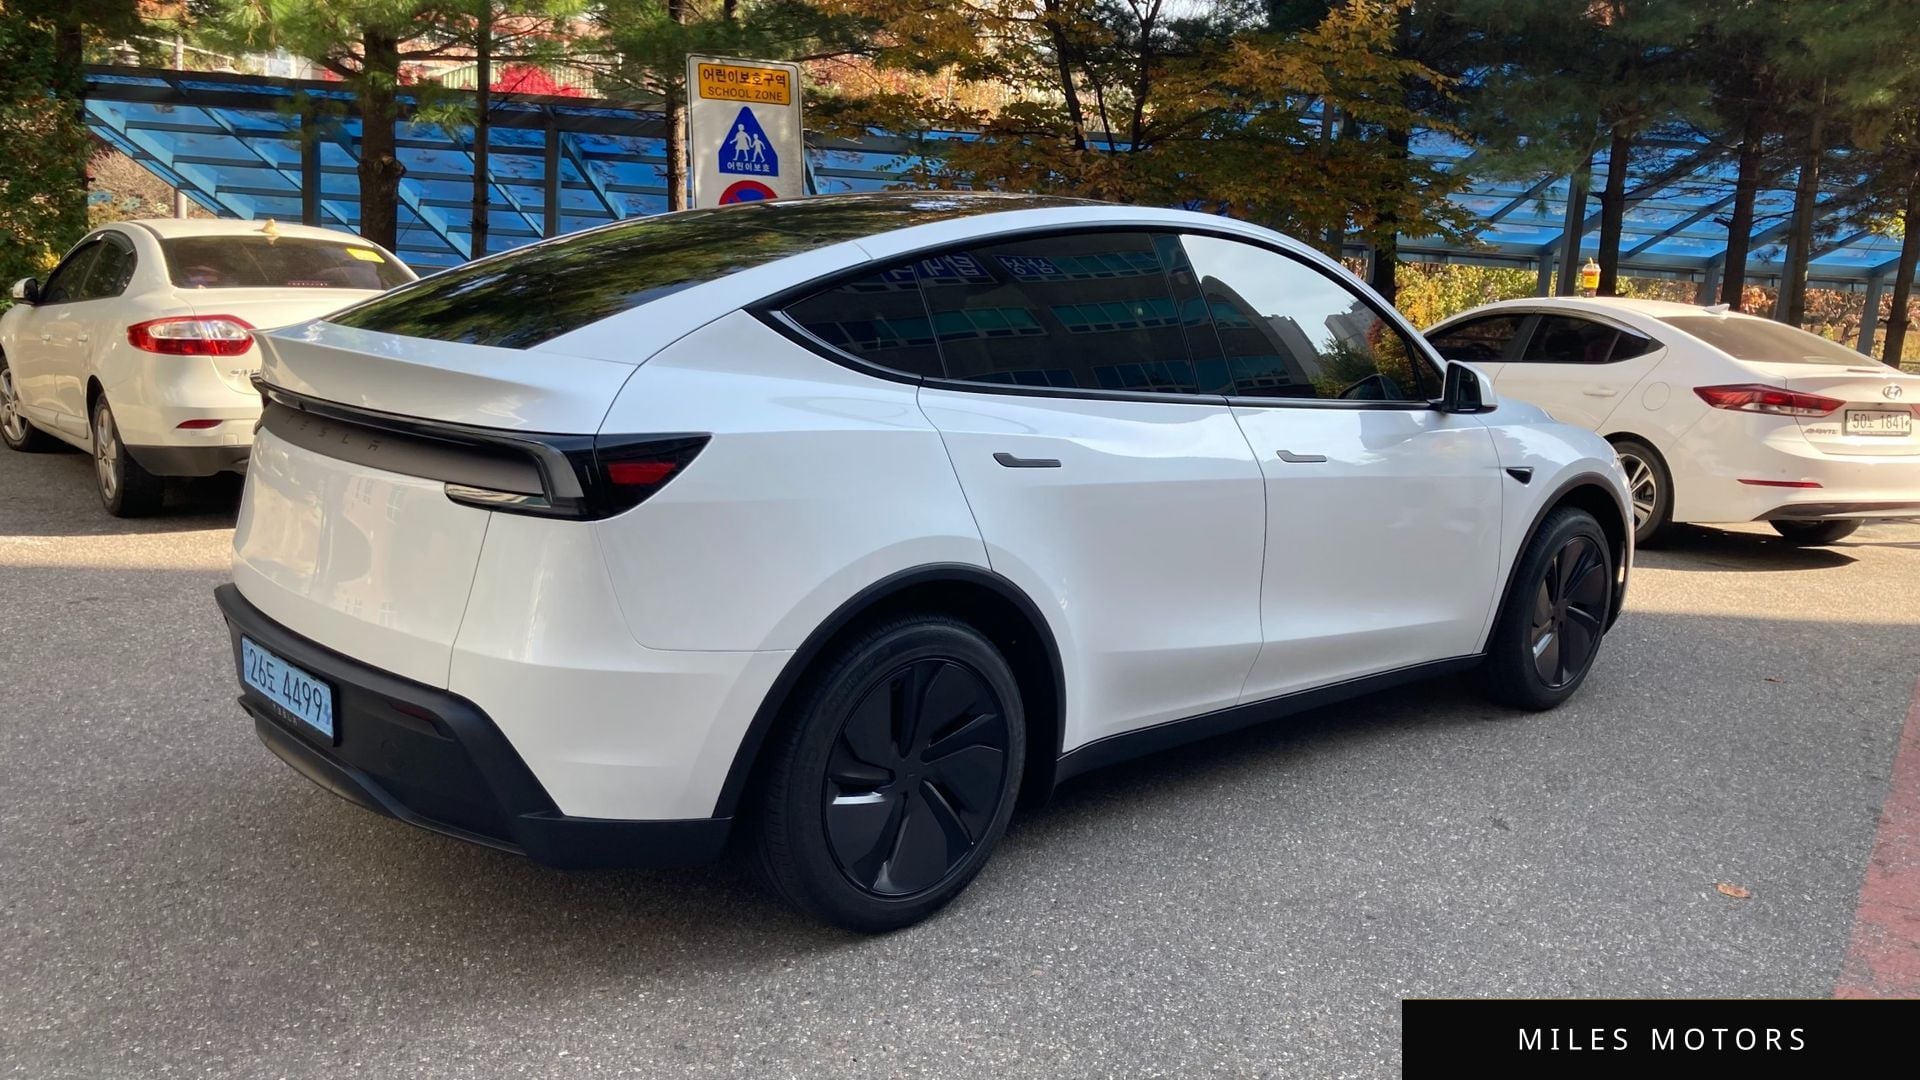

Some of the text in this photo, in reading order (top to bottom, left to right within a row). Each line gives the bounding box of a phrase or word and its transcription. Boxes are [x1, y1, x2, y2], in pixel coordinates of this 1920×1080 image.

[703, 68, 786, 88] 어린이보호구역
[708, 86, 783, 101] SCHOOL ZONE
[727, 161, 770, 172] 어린이보호
[1880, 414, 1904, 429] 1841
[284, 413, 380, 450] TESLA
[249, 647, 323, 721] 26도 4499
